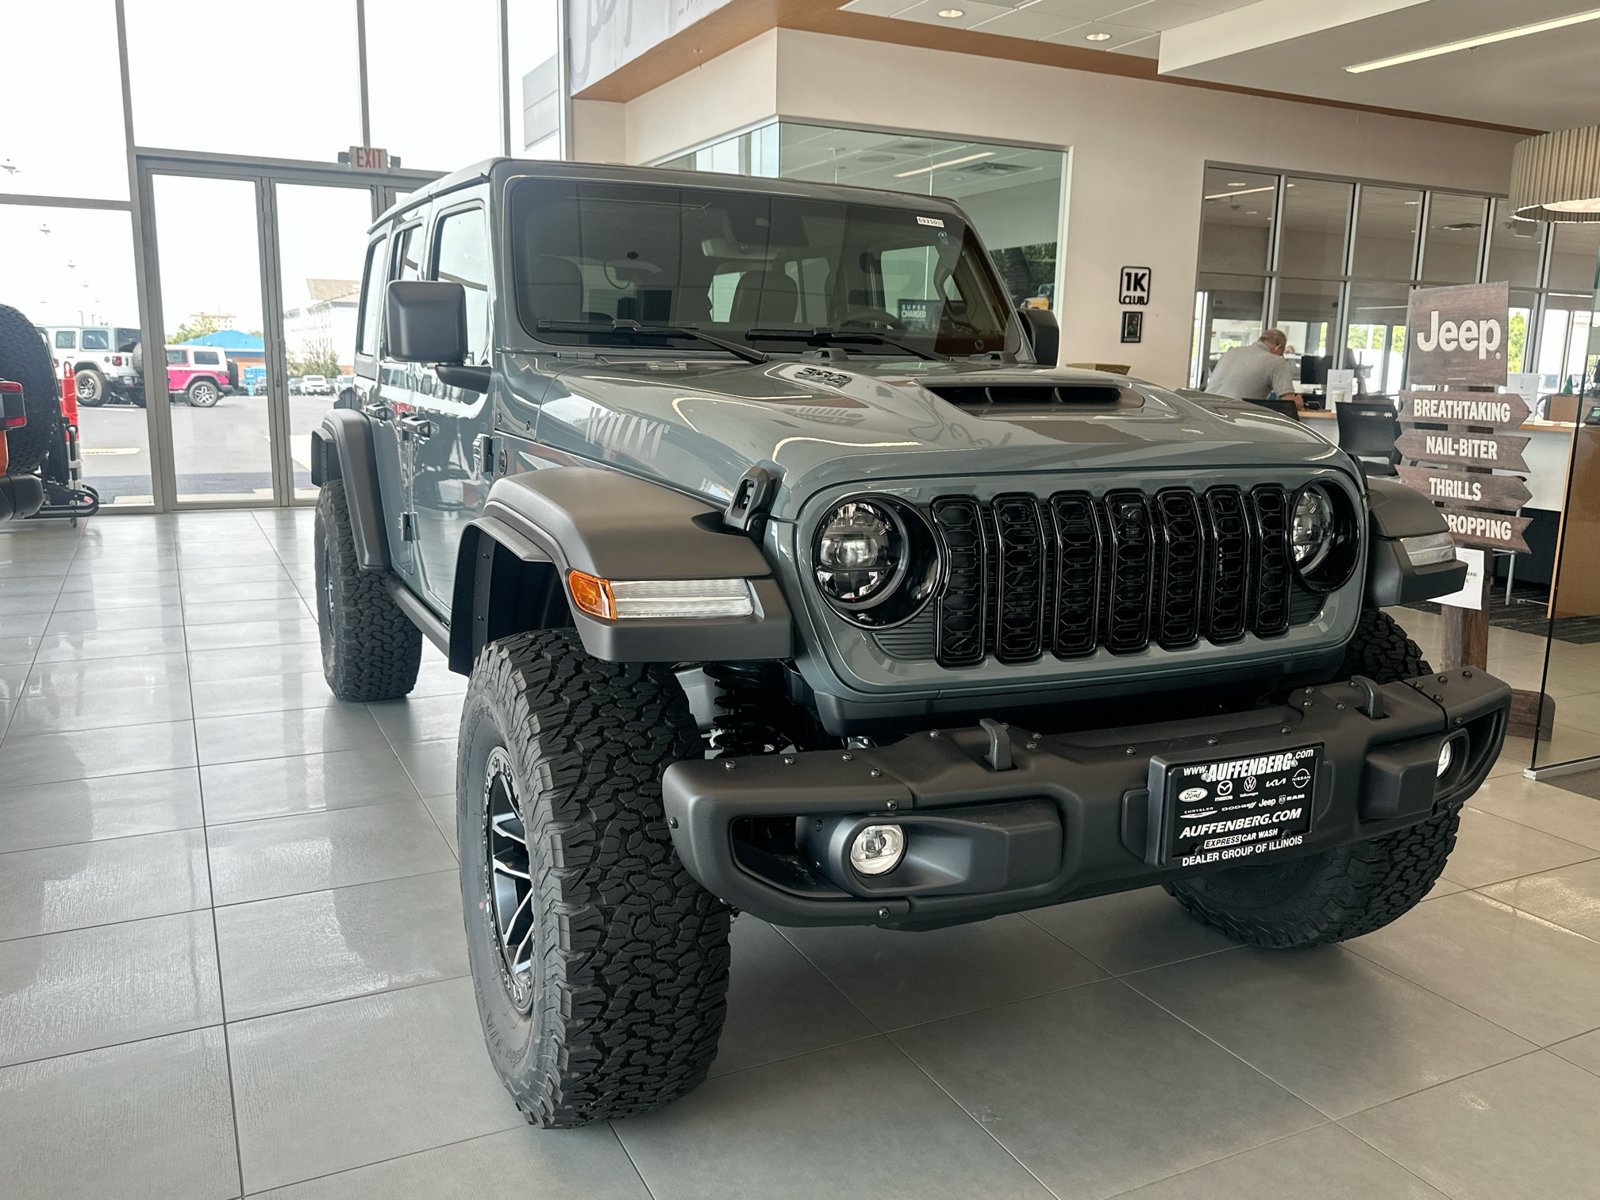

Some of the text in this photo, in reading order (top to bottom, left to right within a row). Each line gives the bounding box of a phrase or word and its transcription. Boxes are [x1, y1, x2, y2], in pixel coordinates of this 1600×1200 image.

[356, 147, 383, 169] EXIT
[1125, 272, 1147, 292] 1K
[1123, 294, 1145, 305] CLUB
[1416, 310, 1501, 360] Jeep
[1413, 398, 1511, 423] BREATHTAKING
[1426, 435, 1498, 460] NAIL-BITER
[1428, 477, 1482, 502] THRILLS
[1258, 798, 1277, 808] Jeep
[1286, 793, 1305, 801] RAM
[1183, 806, 1214, 814] CHRYSLER
[1179, 807, 1303, 839] AUFFENBERG.COM
[1205, 828, 1279, 848] EXPRESS CAR WASH
[1182, 835, 1303, 867] DEALER GROUP OF ILLINOIS
